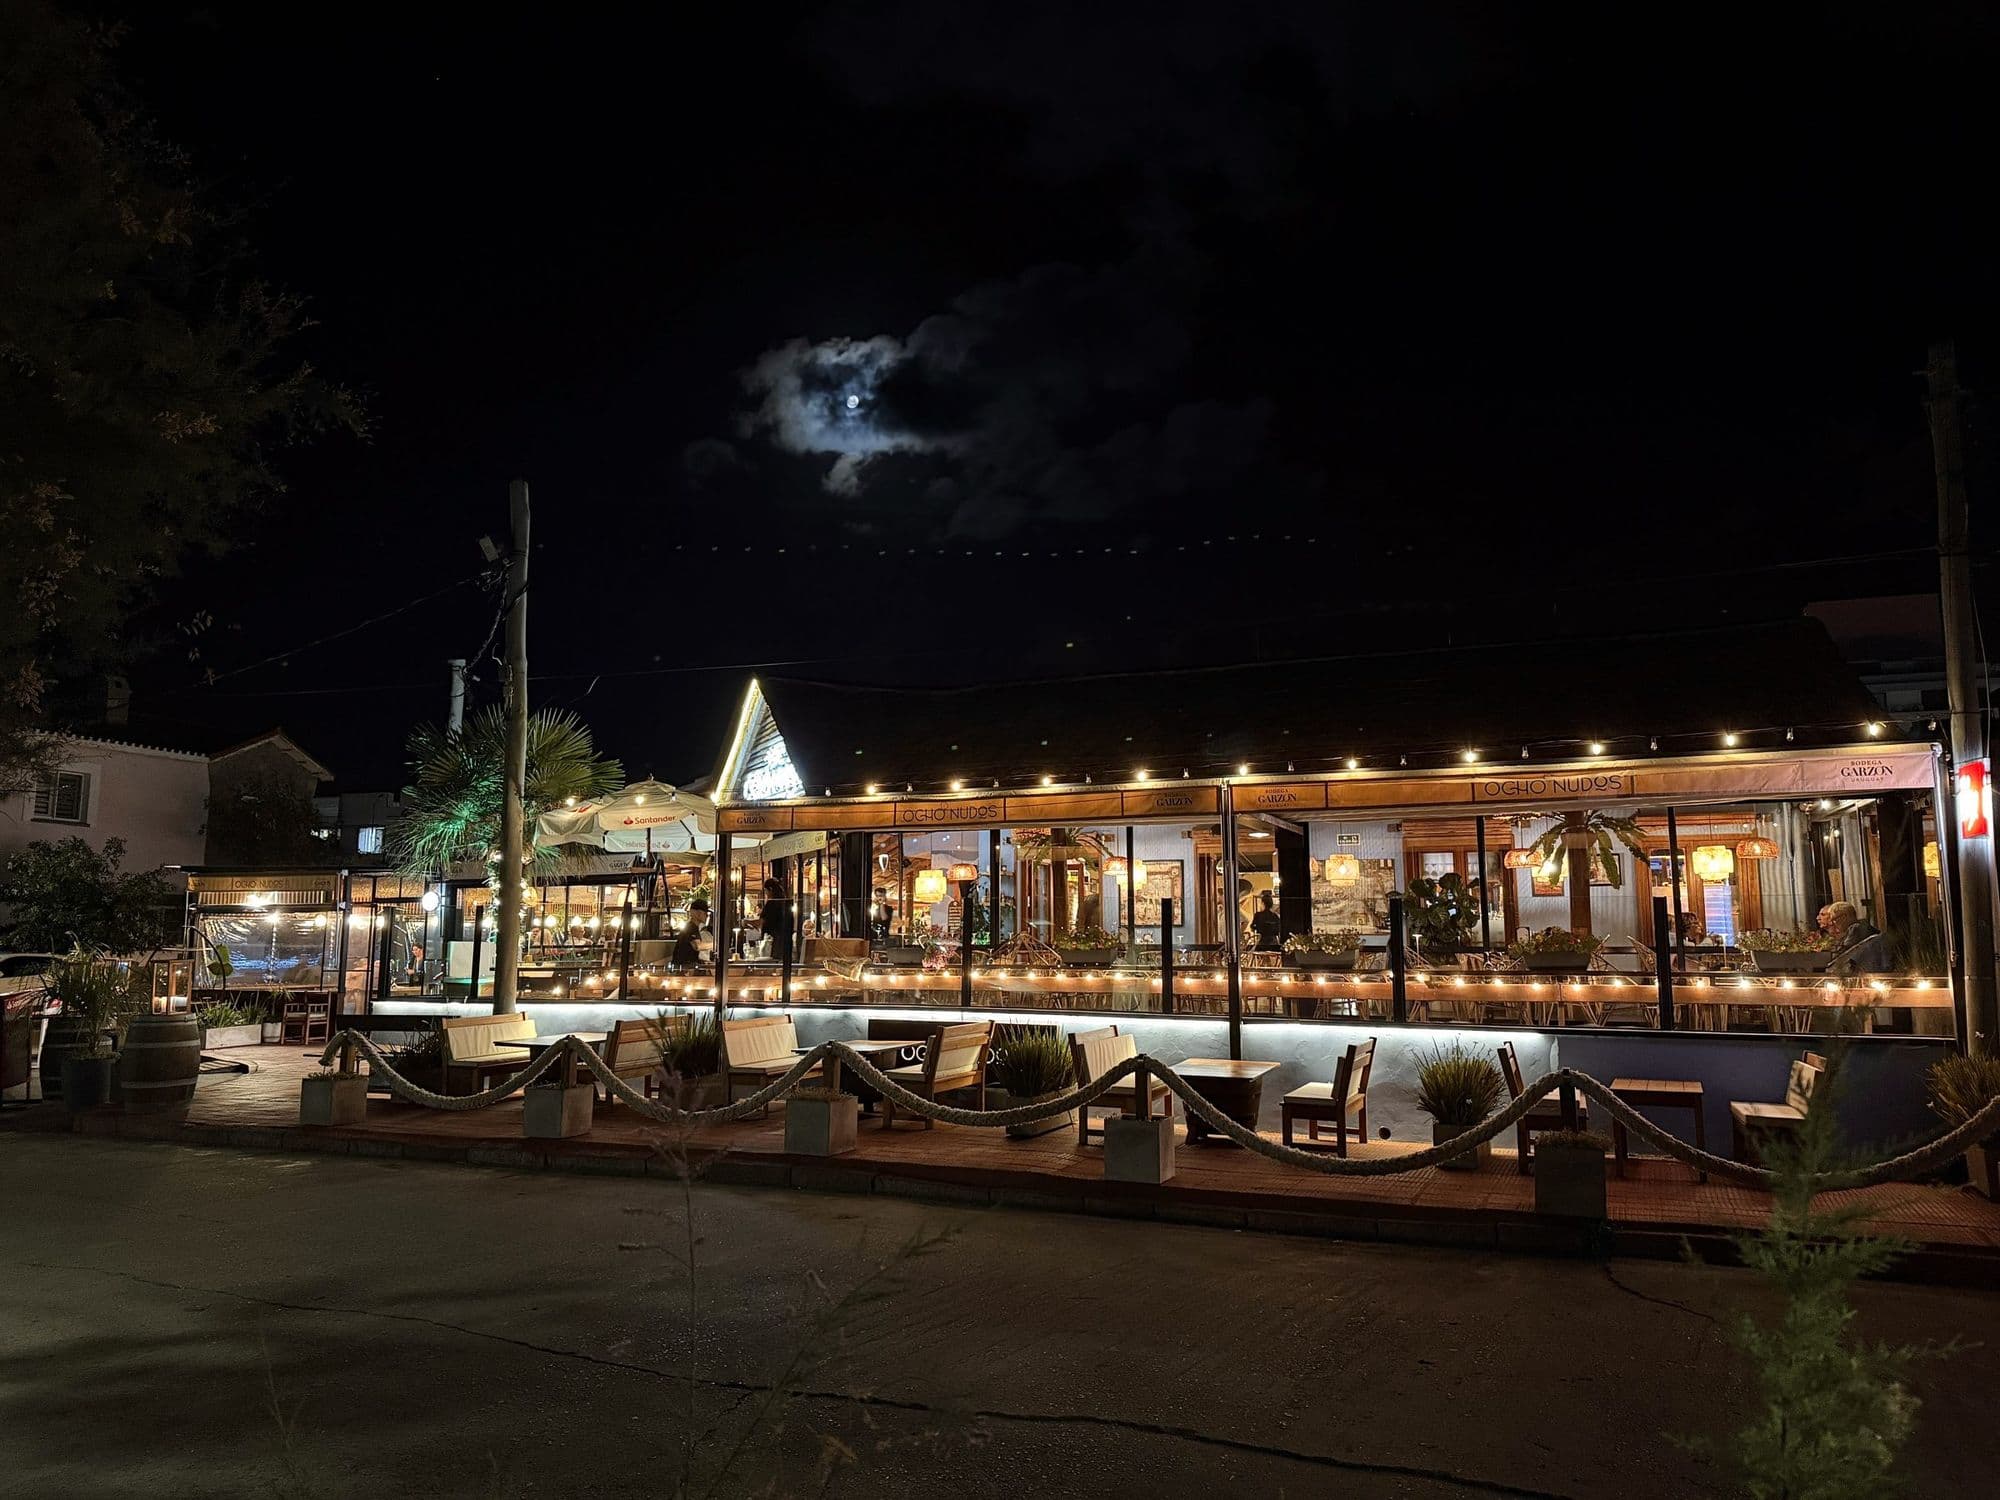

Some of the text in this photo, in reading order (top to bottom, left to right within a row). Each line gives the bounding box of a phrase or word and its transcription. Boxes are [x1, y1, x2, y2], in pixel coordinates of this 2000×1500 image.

[1484, 775, 1622, 796] OCHO NUDOS
[634, 815, 677, 825] Santander
[902, 805, 998, 823] OCHO NUDOS
